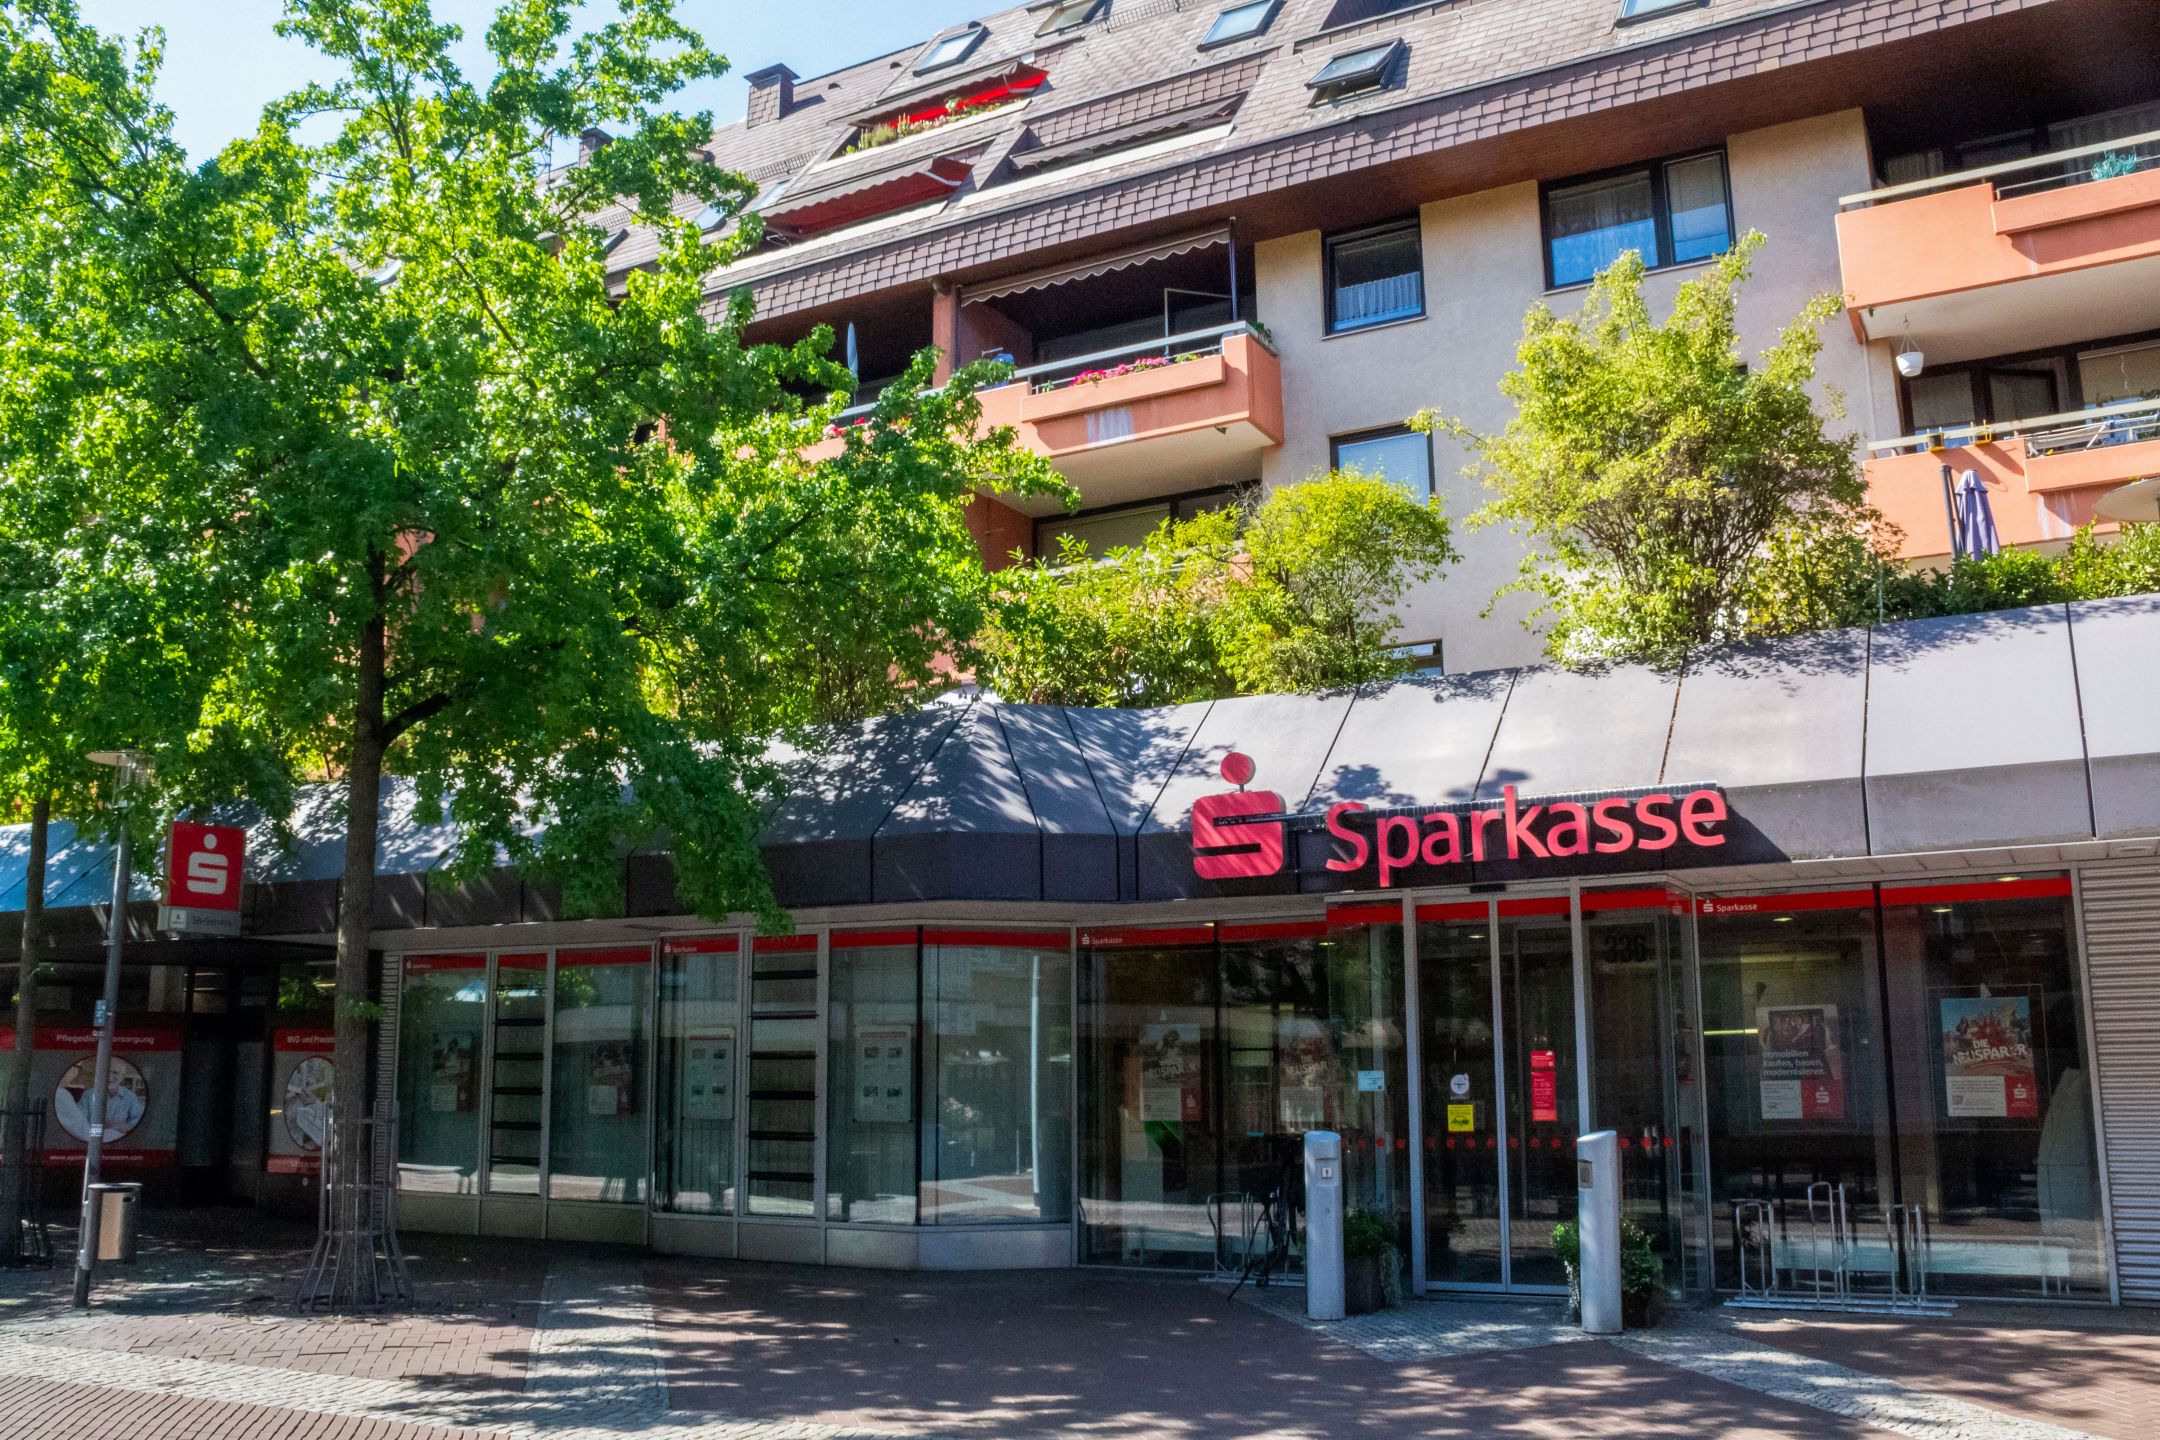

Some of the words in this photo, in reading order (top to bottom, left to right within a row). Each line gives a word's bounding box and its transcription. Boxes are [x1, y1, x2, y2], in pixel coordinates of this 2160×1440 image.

[1325, 785, 1728, 887] Sparkasse
[1716, 903, 1758, 914] Sparkasse
[1973, 1038, 1990, 1049] DIE
[1762, 1049, 1809, 1058] Immobilien
